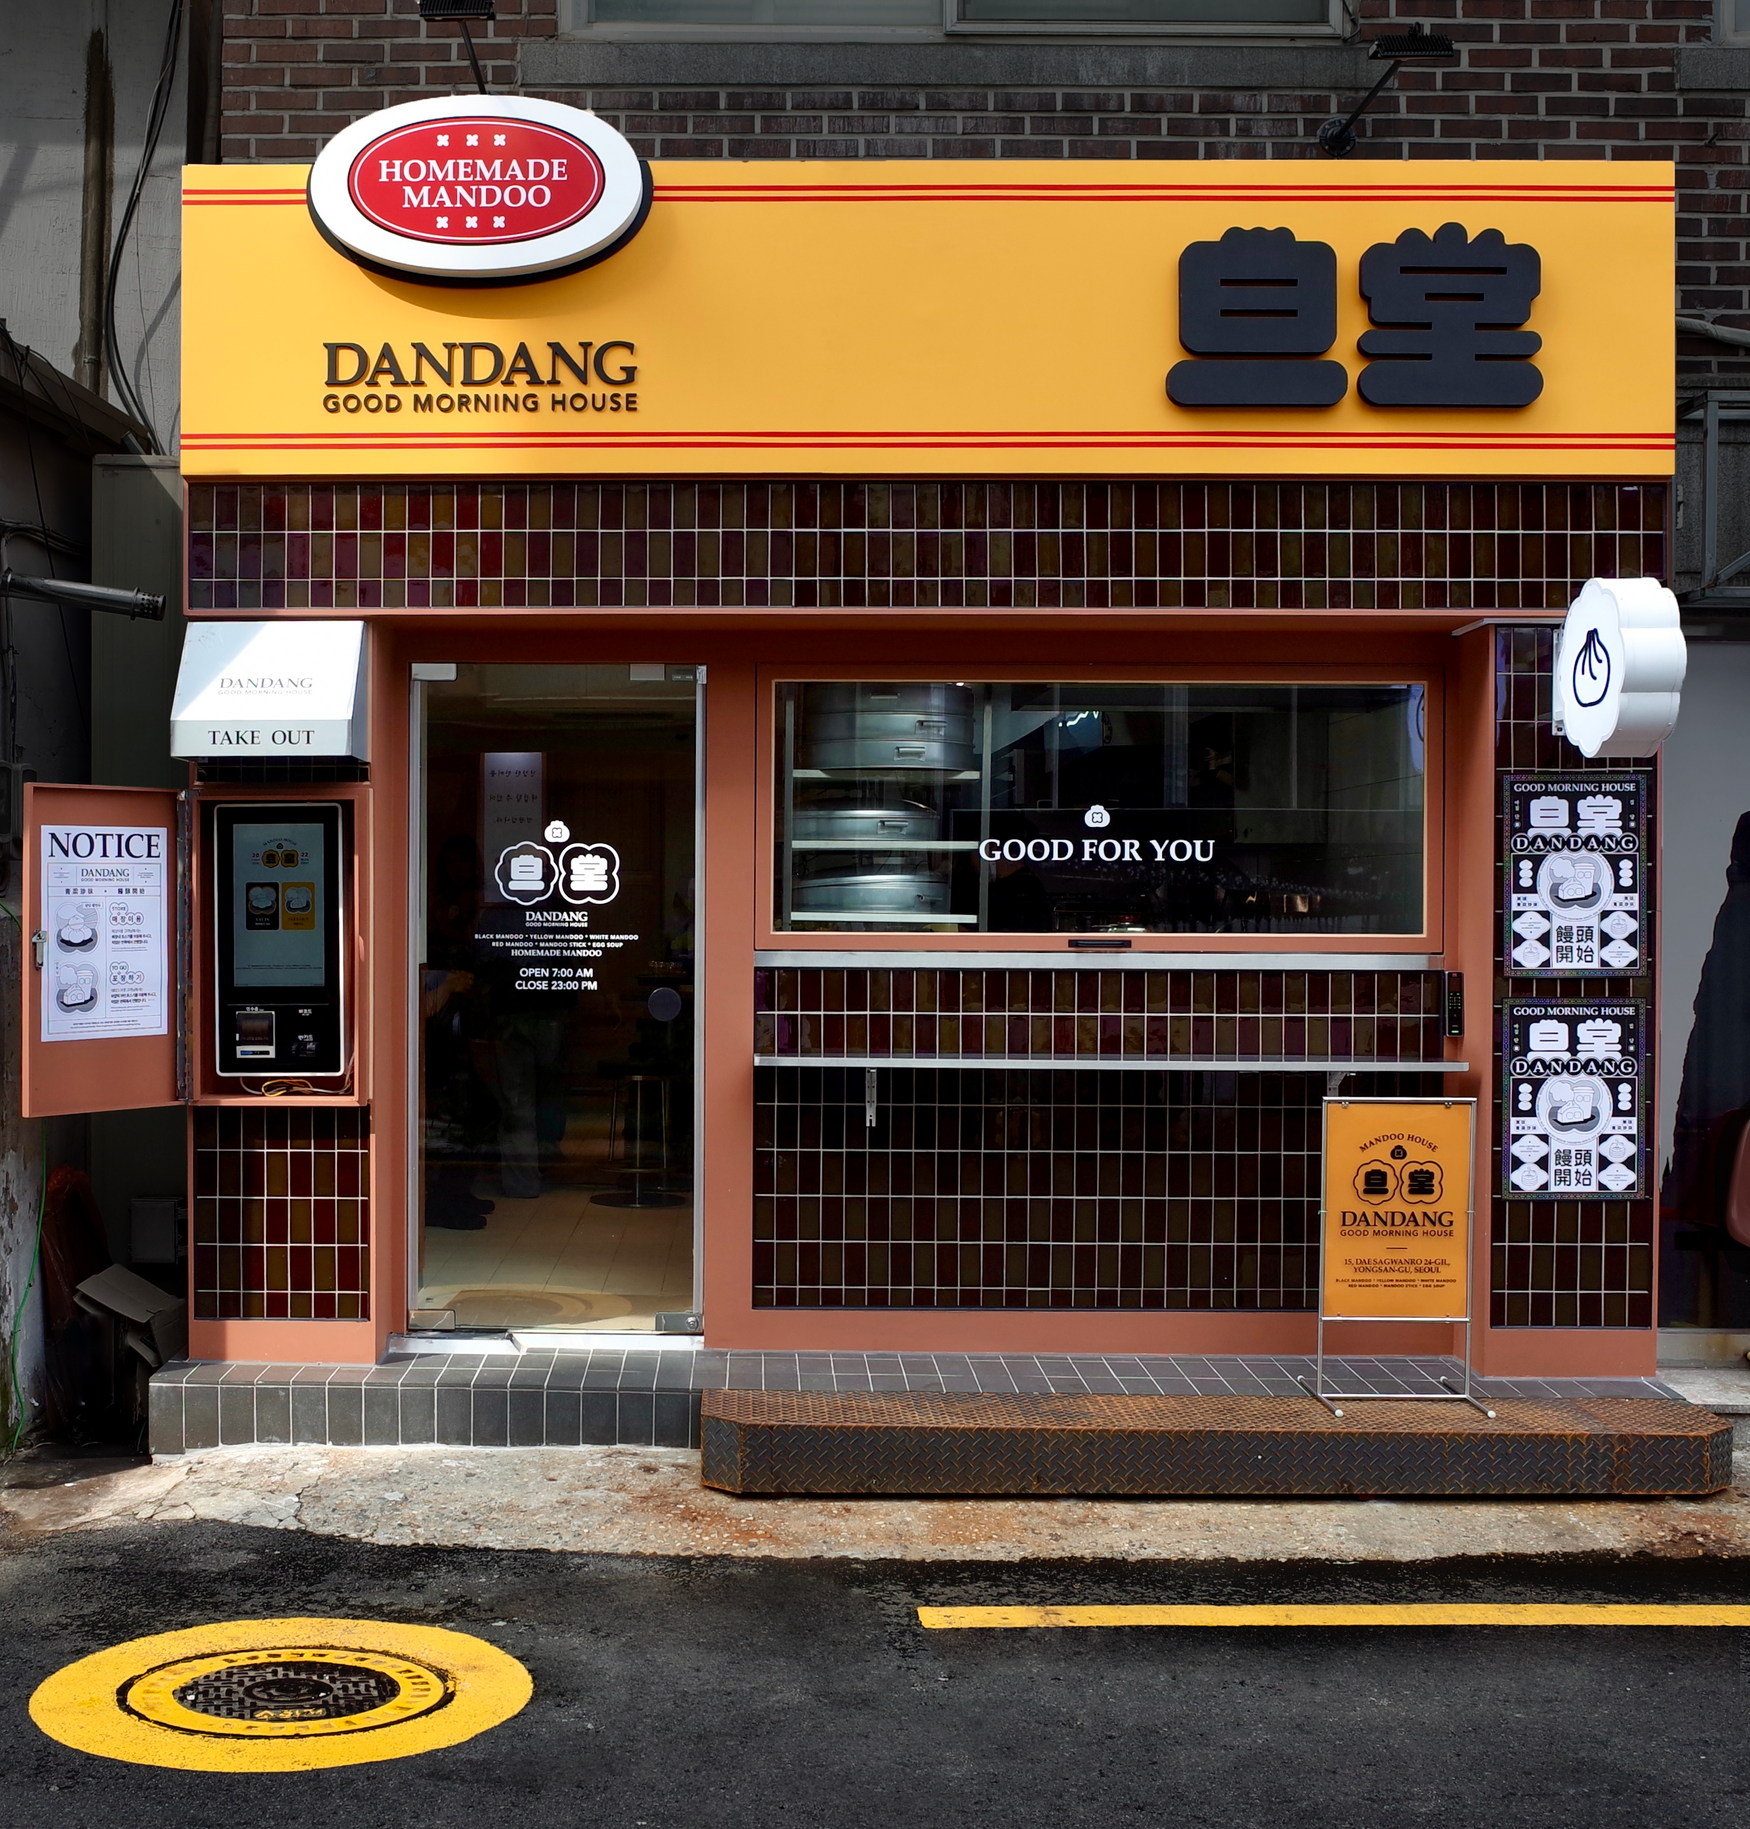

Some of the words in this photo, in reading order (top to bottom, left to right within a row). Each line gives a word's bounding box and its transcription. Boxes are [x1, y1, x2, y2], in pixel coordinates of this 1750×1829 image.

[379, 159, 568, 182] HOMEMADE
[401, 185, 552, 208] MANDOO
[323, 341, 638, 388] DANDANG
[323, 393, 402, 413] GOOD
[413, 393, 539, 412] MORNING
[551, 393, 638, 412] HOUSE
[219, 677, 313, 689] DANDANG
[207, 730, 261, 745] TAKE
[271, 730, 315, 745] OUT
[1513, 783, 1545, 793] GOOD
[1547, 783, 1599, 792] MORNING
[1601, 783, 1636, 792] HOUSE
[48, 832, 161, 859] NOTICE
[1515, 836, 1634, 850] DANDANG
[979, 839, 1074, 862] GOOD
[1081, 839, 1143, 862] FOR
[1150, 839, 1215, 862] YOU
[81, 868, 130, 878] DANDANG
[525, 911, 588, 922] DANDANG
[511, 949, 561, 957] HOMEMADE
[562, 949, 603, 957] MANDOO
[1555, 945, 1595, 963] 開始
[112, 974, 142, 982] 포장하기
[519, 968, 549, 978] OPEN
[551, 968, 573, 978] 7:00
[575, 968, 594, 978] AM
[515, 981, 549, 991] CLOSE
[551, 981, 579, 991] 23:00
[581, 981, 598, 991] PM
[1513, 1006, 1545, 1016] GOOD
[1547, 1006, 1599, 1016] MORNING
[1600, 1006, 1636, 1015] HOUSE
[1515, 1060, 1633, 1074] DANDANG
[1358, 1132, 1405, 1153] MANDOO
[1406, 1133, 1439, 1153] HOUSE
[1554, 1168, 1593, 1187] 開始
[1340, 1210, 1454, 1228] DANDANG
[1340, 1229, 1370, 1237] GOOD
[1372, 1229, 1419, 1237] MORNING
[1422, 1229, 1455, 1237] HOUSE
[1344, 1258, 1354, 1267] 15,
[1355, 1258, 1423, 1266] DAESAGWANRO
[1424, 1258, 1451, 1267] 24-GIL,
[1353, 1266, 1413, 1275] YONGSAN-GU,
[1414, 1266, 1441, 1274] SEOUL
